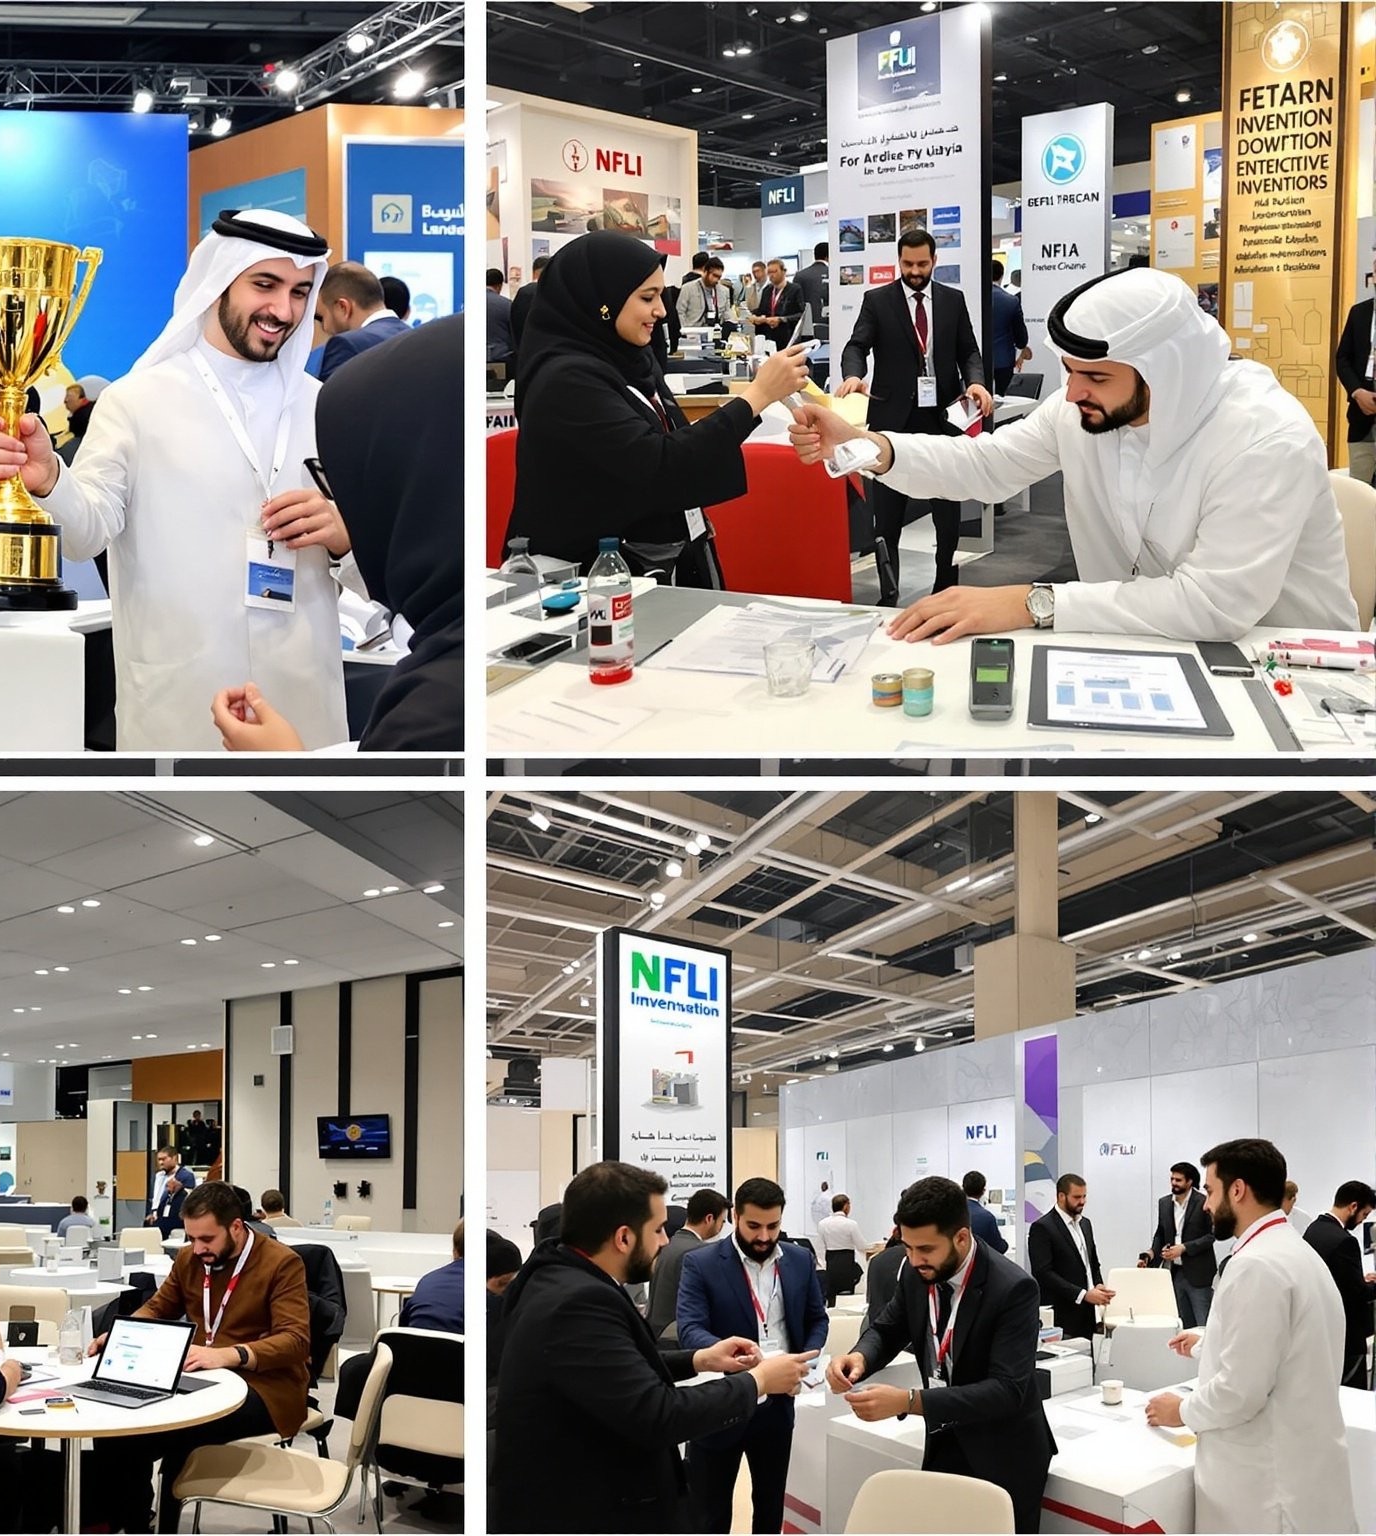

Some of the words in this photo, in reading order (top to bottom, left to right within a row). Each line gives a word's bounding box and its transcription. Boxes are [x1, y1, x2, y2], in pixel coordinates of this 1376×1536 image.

[1240, 77, 1333, 111] FETARN
[1236, 107, 1332, 135] INVENTION
[596, 148, 642, 177] NFLI
[769, 187, 795, 205] NFLI
[1237, 175, 1328, 195] INVENTIORS
[1042, 243, 1079, 258] NFIA
[632, 951, 718, 1002] NFLI
[966, 1124, 997, 1140] NFLI
